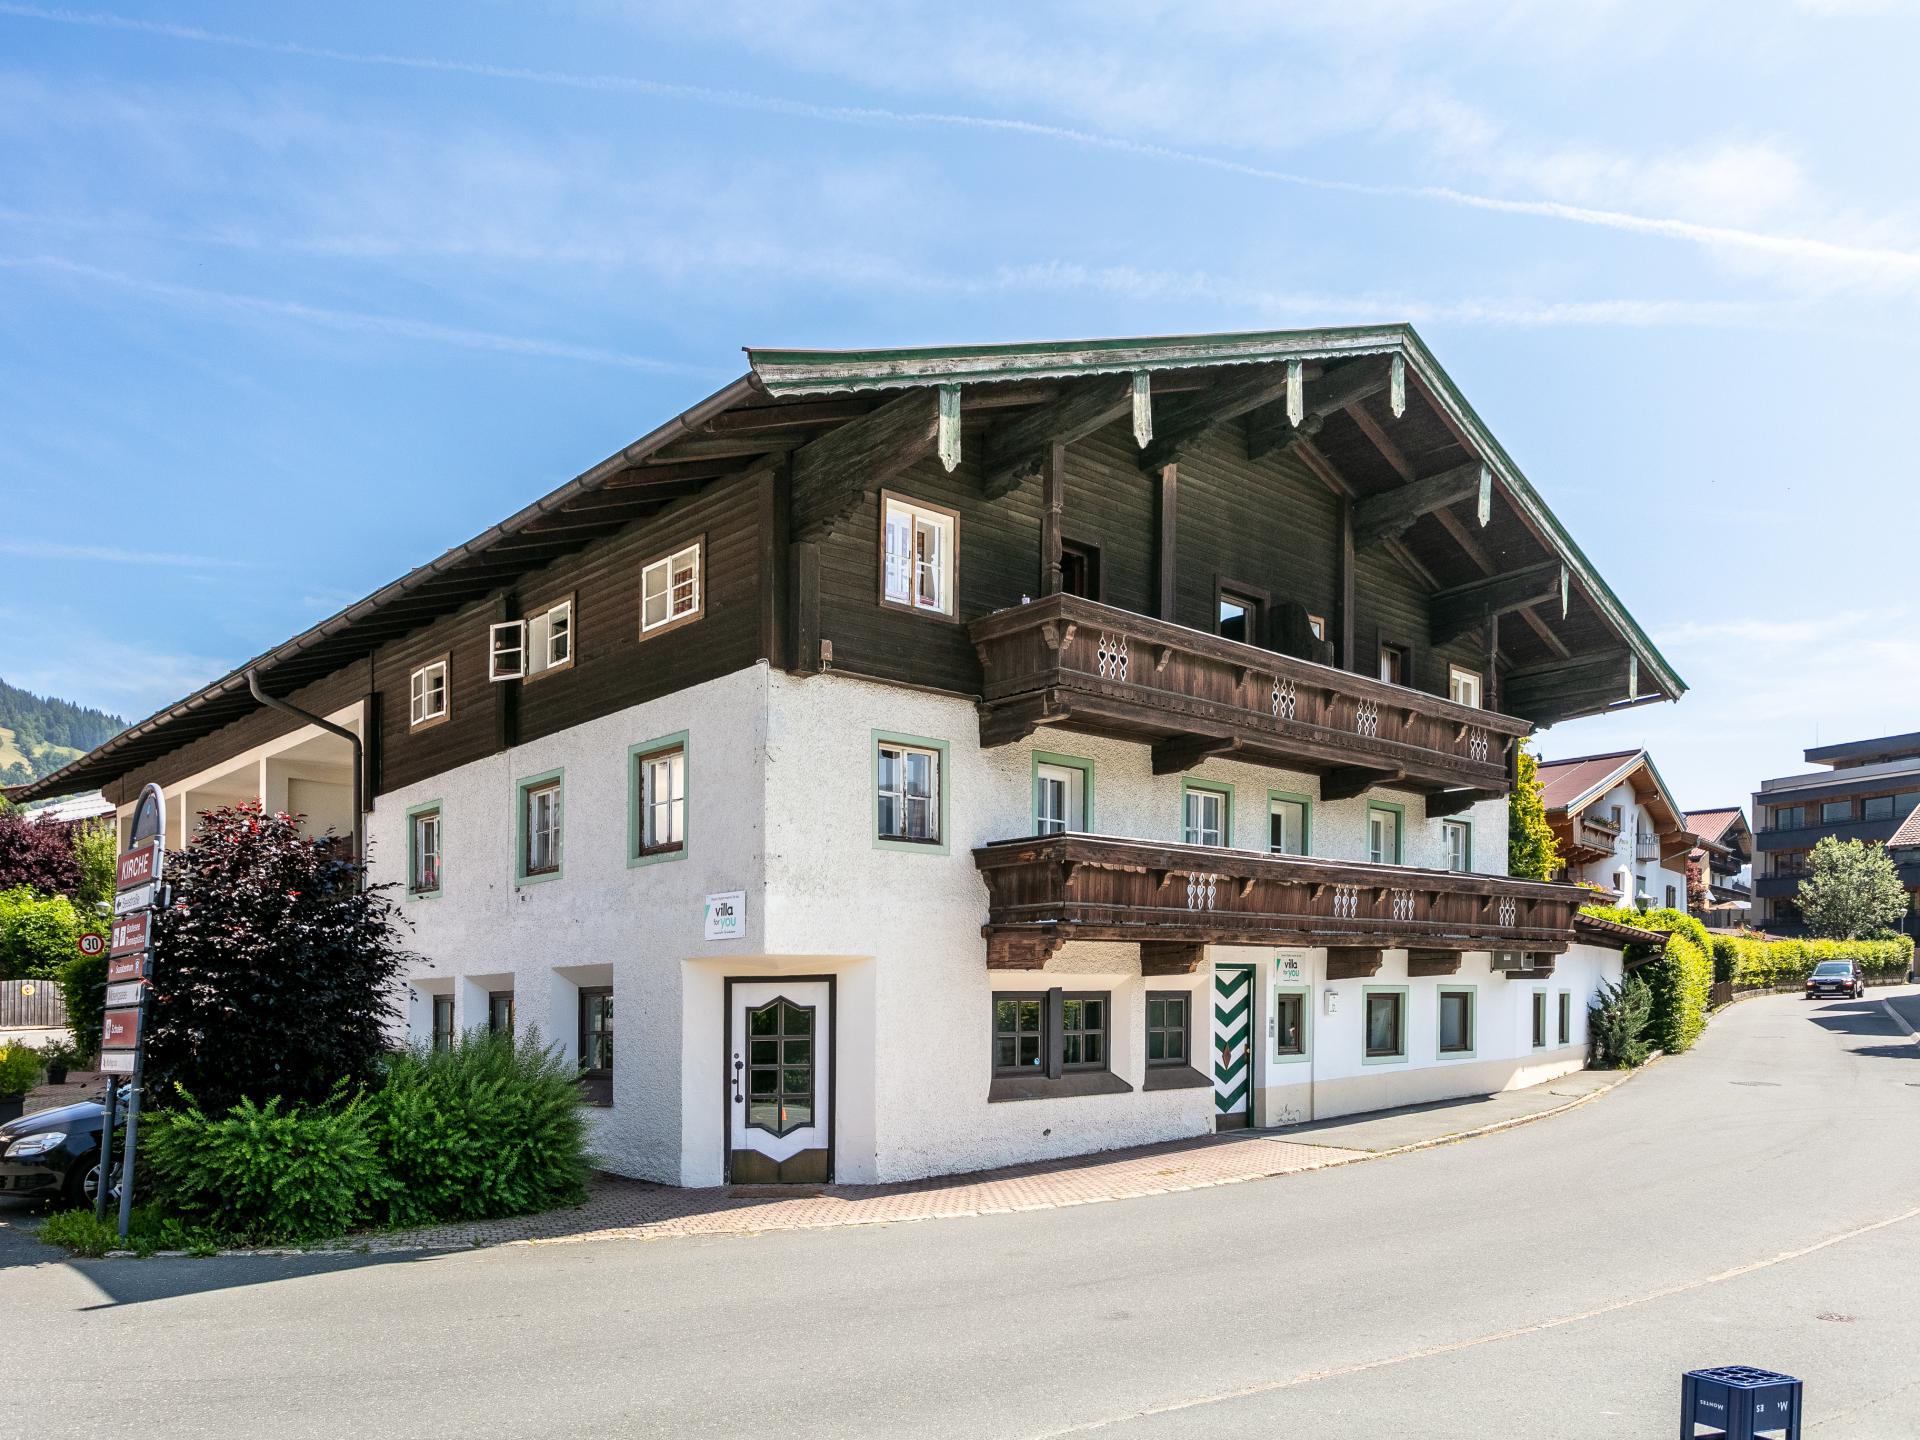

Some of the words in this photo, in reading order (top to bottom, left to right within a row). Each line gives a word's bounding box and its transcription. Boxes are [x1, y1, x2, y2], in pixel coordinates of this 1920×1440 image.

[122, 853, 149, 880] KIRCHE
[715, 903, 733, 916] villa
[720, 917, 737, 929] you
[84, 938, 99, 950] 30
[1285, 959, 1297, 968] villa
[1288, 970, 1299, 978] you
